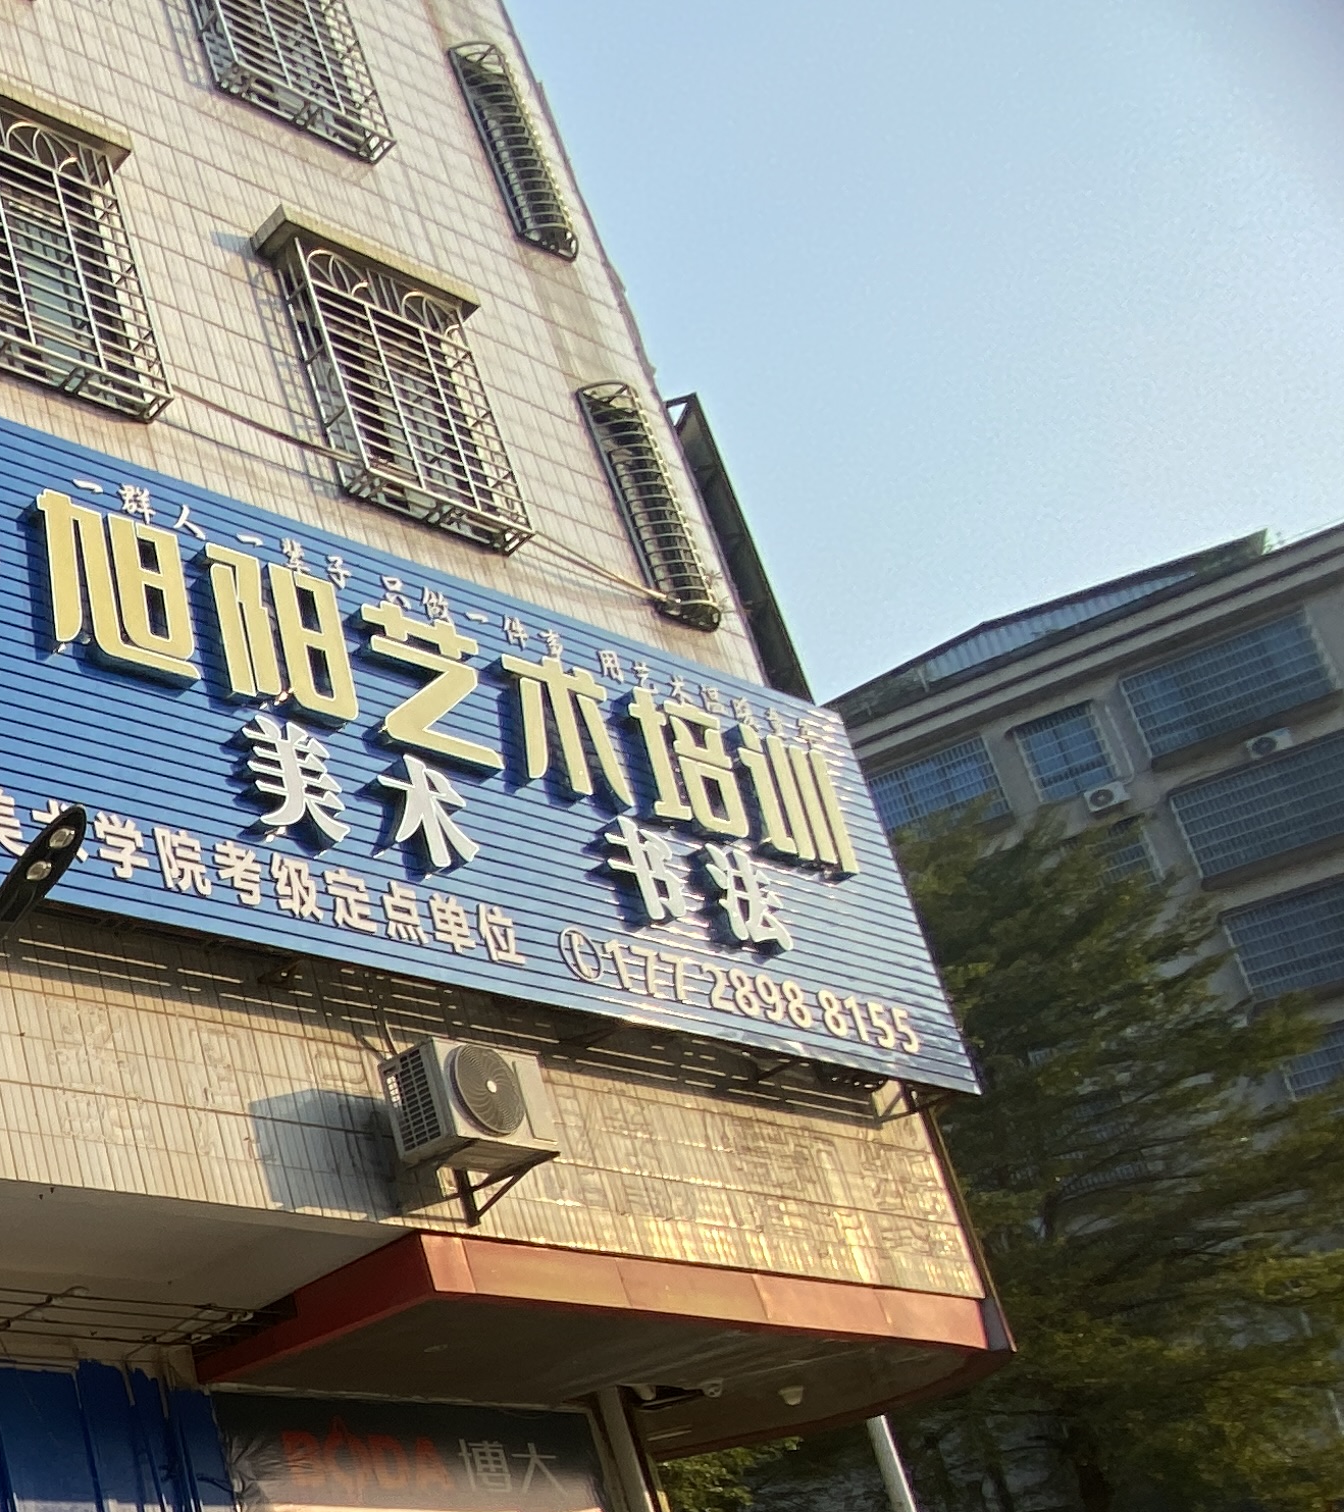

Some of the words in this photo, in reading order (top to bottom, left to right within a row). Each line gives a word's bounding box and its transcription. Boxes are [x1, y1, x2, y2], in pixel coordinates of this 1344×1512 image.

[73, 477, 206, 541] 一群人
[35, 489, 859, 876] 旭阳艺术培训
[242, 716, 480, 868] 美术
[606, 816, 794, 952] 书法
[603, 937, 690, 1002] 177
[698, 961, 813, 1030] 2898
[821, 987, 923, 1056] 8155
[457, 1438, 568, 1495] 博大
